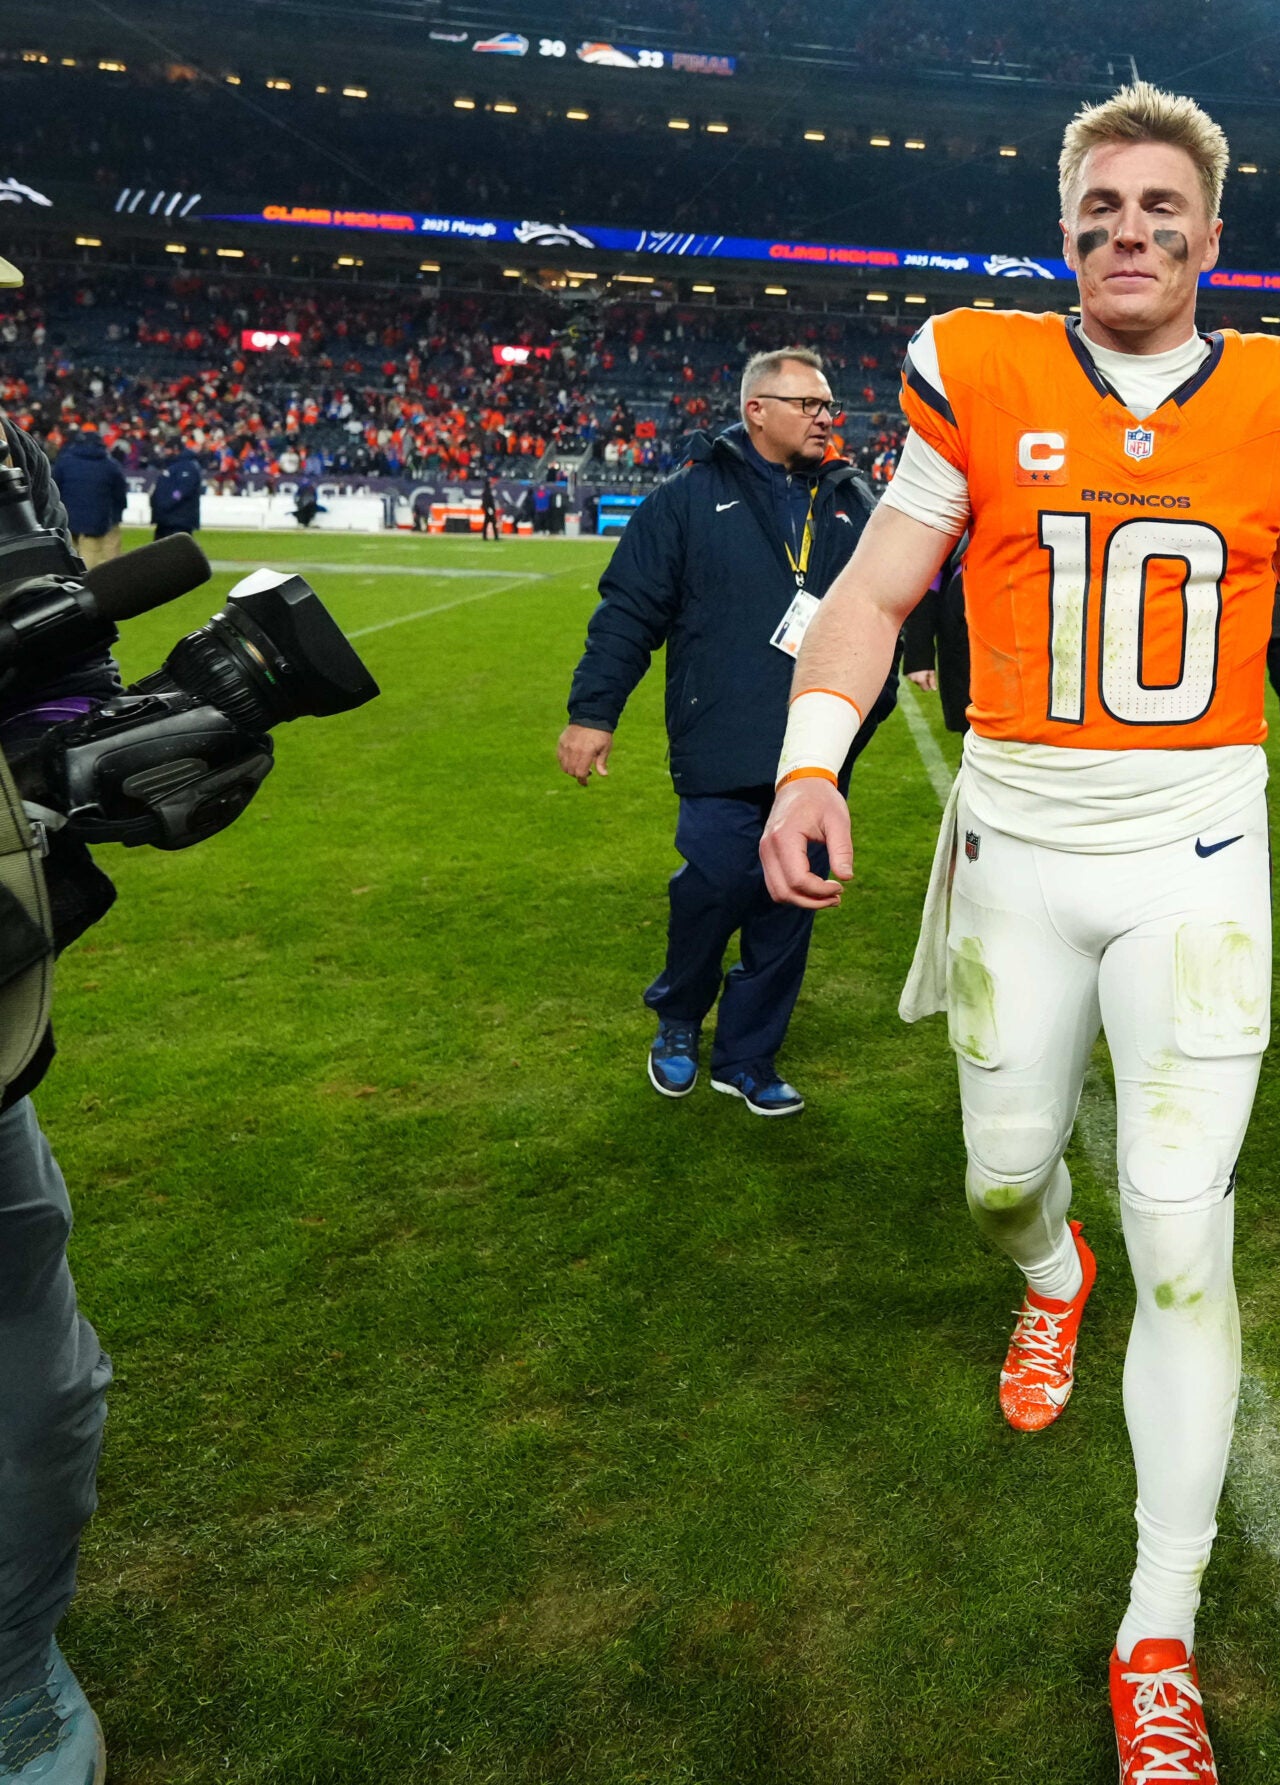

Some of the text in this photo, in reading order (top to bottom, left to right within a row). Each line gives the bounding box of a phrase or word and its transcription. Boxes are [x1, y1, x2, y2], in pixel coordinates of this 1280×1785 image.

[1018, 431, 1065, 471] C
[1129, 440, 1149, 455] NFL
[1080, 489, 1191, 509] BRONCOS
[1037, 509, 1228, 727] 10
